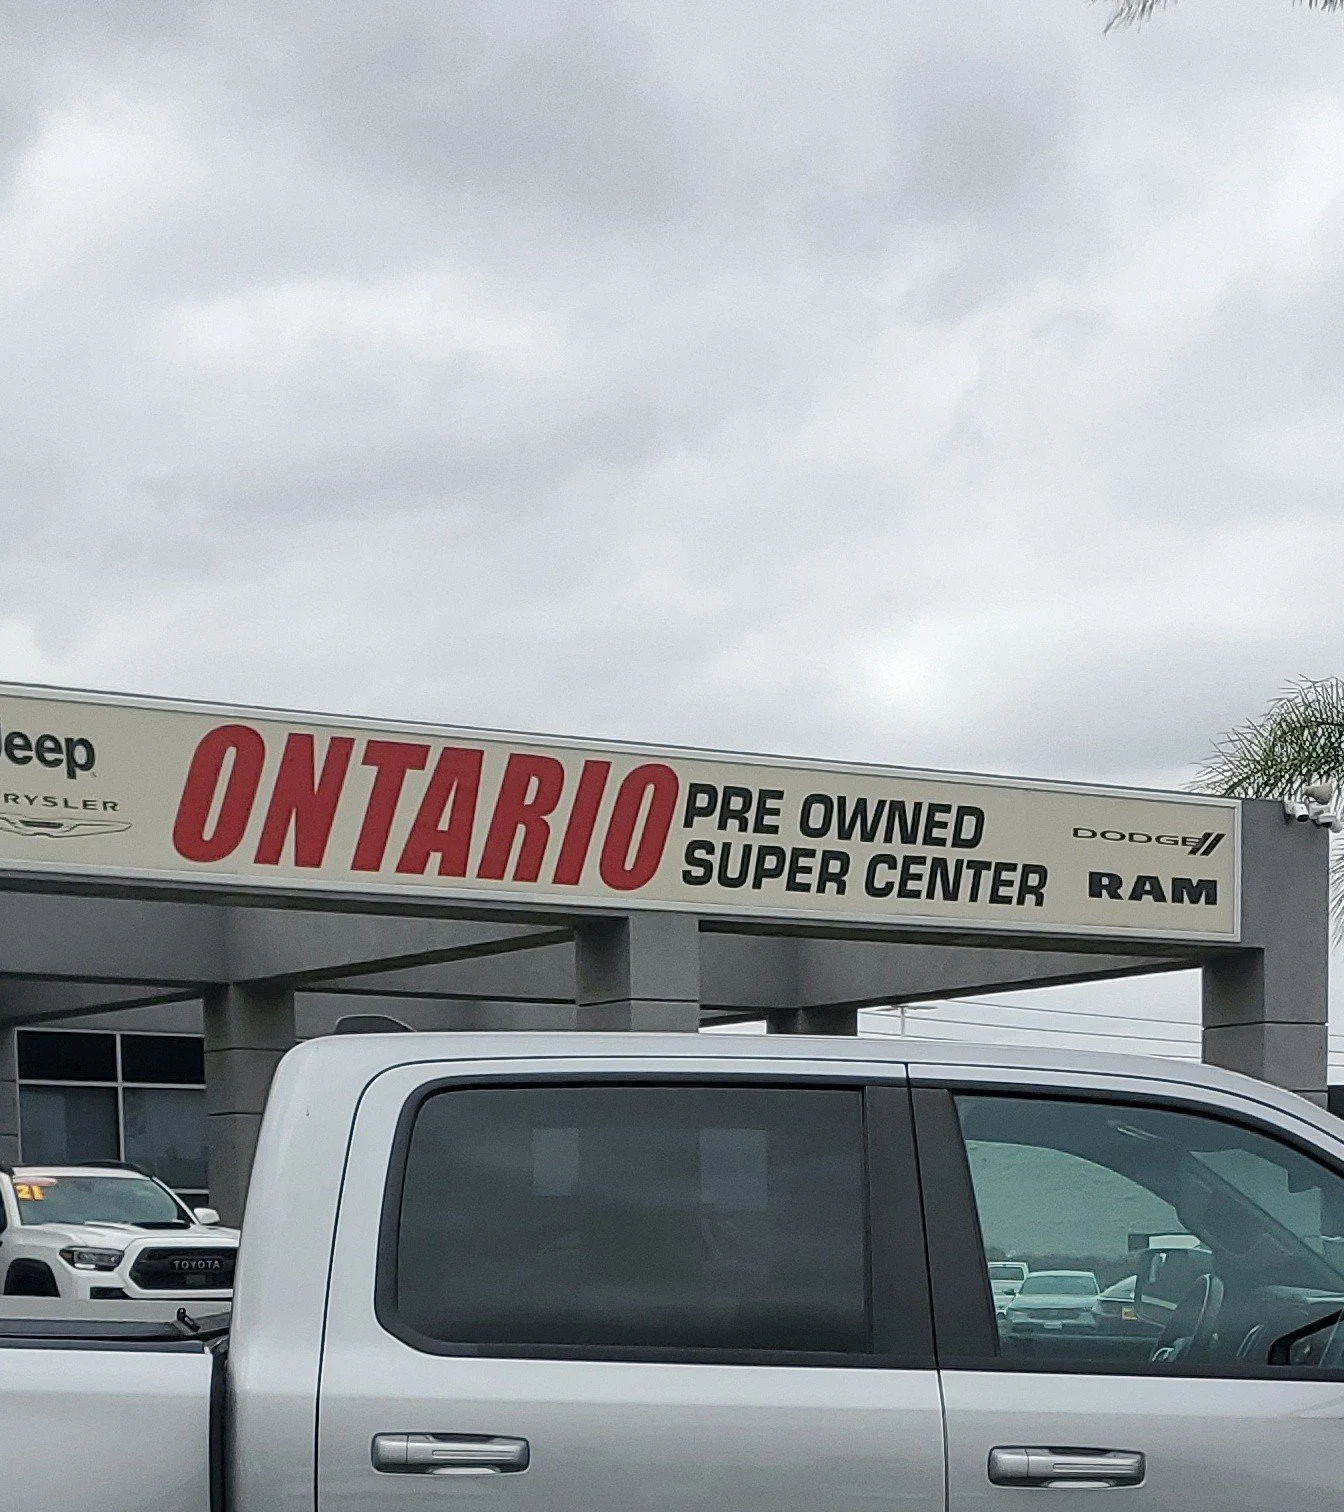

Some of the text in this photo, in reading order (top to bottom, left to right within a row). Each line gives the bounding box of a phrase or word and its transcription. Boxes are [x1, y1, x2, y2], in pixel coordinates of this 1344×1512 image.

[172, 724, 680, 892] ONTARIO
[682, 782, 986, 850] PRE OWNED
[1072, 827, 1203, 847] DODGE
[681, 839, 1048, 908] SUPER CENTER
[1088, 870, 1218, 906] RAM
[15, 1184, 44, 1201] 21
[173, 1260, 220, 1269] TOYOTA
